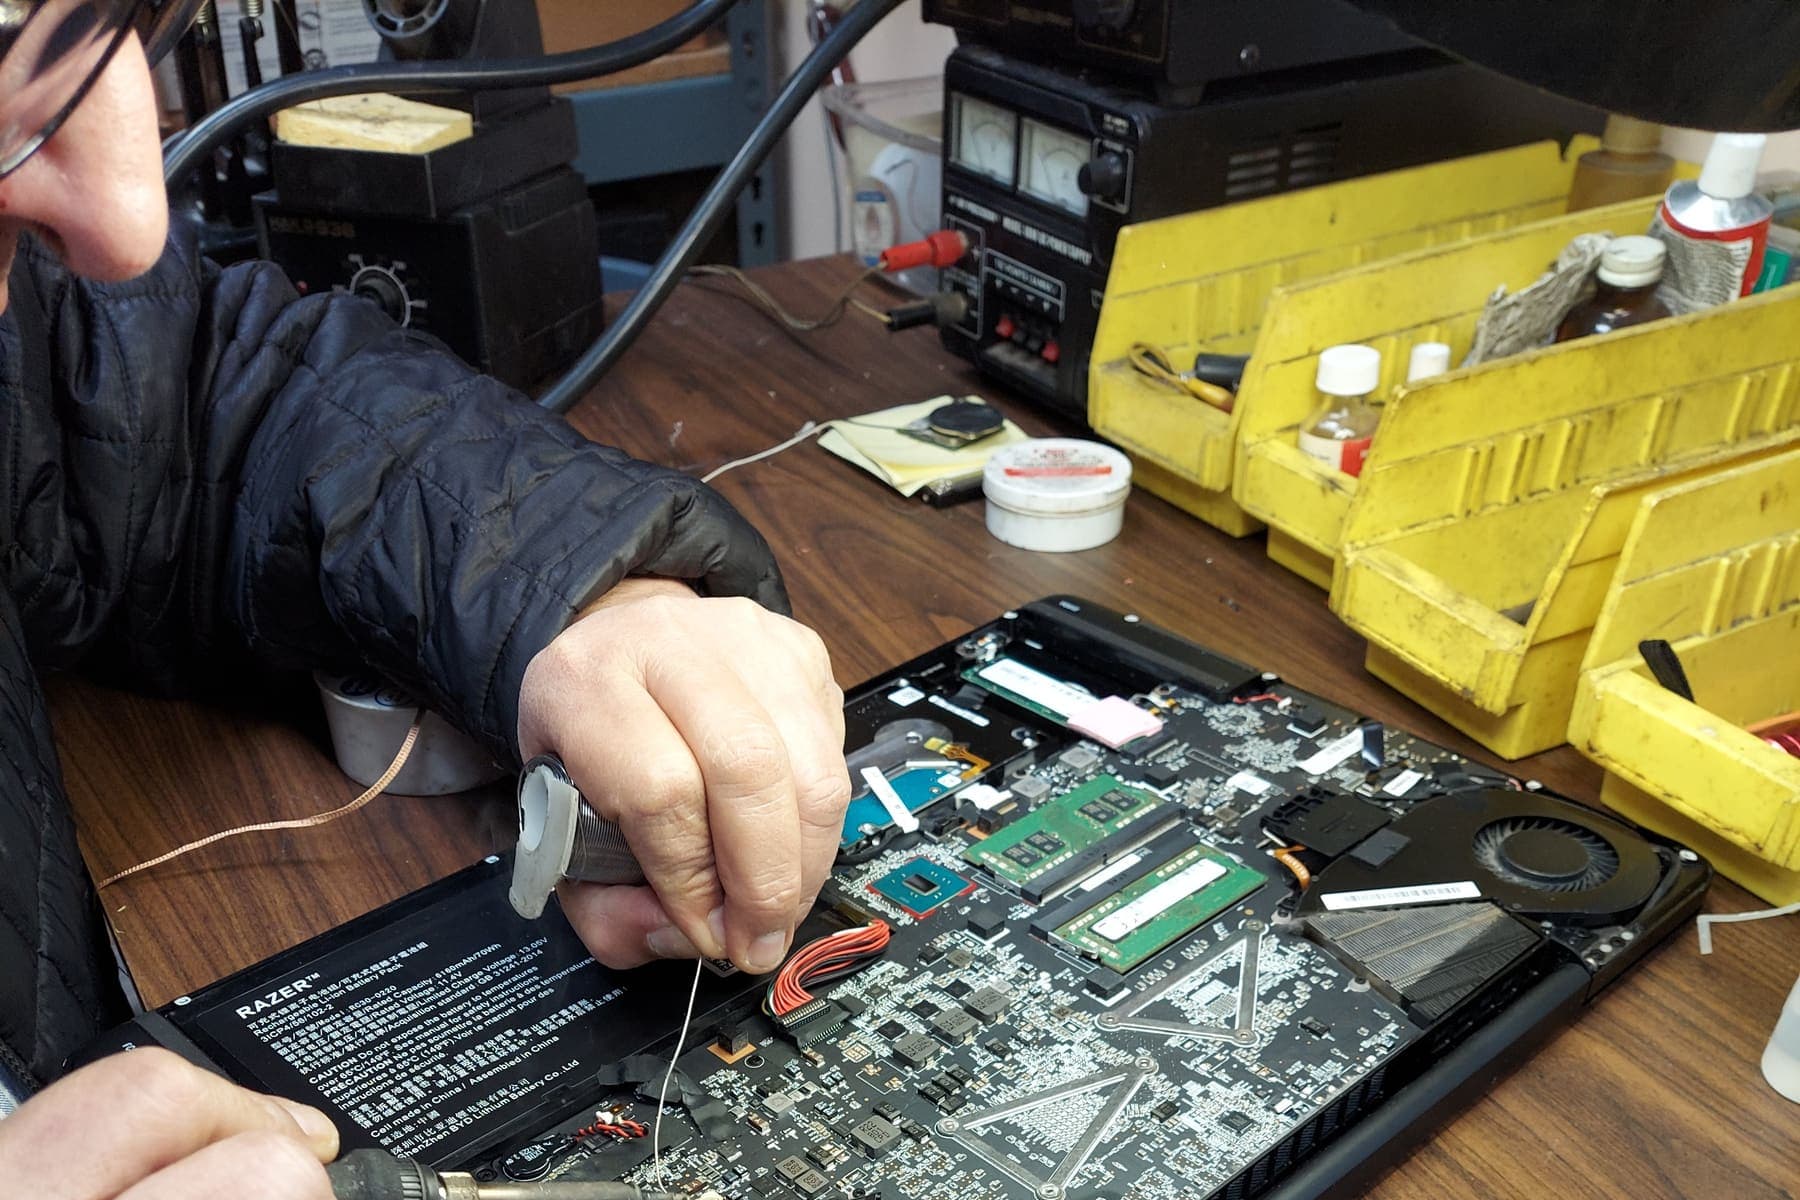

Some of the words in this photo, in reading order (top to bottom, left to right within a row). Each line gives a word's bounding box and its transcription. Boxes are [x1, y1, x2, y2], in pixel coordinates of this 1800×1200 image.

[252, 1002, 322, 1037] Rechargeable
[318, 989, 347, 1005] Li-ion
[344, 973, 380, 992] Battery
[378, 962, 404, 976] Pack
[450, 970, 488, 990] Charge
[476, 974, 494, 985] GB
[308, 1056, 359, 1085] CAUTION
[356, 1049, 374, 1060] Do
[373, 1040, 391, 1053] not
[390, 1024, 425, 1046] expose
[423, 1016, 441, 1027] the
[438, 999, 472, 1019] battery
[470, 994, 483, 1003] to
[480, 966, 539, 997] temperatures
[317, 1076, 341, 1092] over
[393, 1039, 415, 1052] See
[414, 1020, 450, 1042] manual
[447, 1015, 463, 1025] for
[462, 1000, 491, 1018] safety
[331, 1072, 391, 1107] supérieures
[472, 1024, 484, 1033] le
[483, 1005, 518, 1027] manuel
[516, 995, 537, 1011] pour
[537, 987, 555, 999] des
[392, 1051, 409, 1062] Ne
[408, 1041, 432, 1055] pas
[427, 1019, 473, 1045] soumettre
[471, 1014, 484, 1022] la
[480, 996, 517, 1017] batterie
[523, 983, 542, 995] des
[337, 1078, 395, 1111] instructions
[394, 1071, 409, 1081] de
[370, 1122, 393, 1138] Cell
[391, 1108, 422, 1127] made
[419, 1102, 433, 1111] in
[431, 1086, 463, 1105] China
[469, 1055, 523, 1086] Assembled
[519, 1051, 533, 1060] in
[530, 1035, 560, 1053] China
[394, 1127, 451, 1162] ShenZhen
[448, 1114, 474, 1133] BYD
[472, 1095, 511, 1120] Lithium
[506, 1079, 545, 1101] Battery
